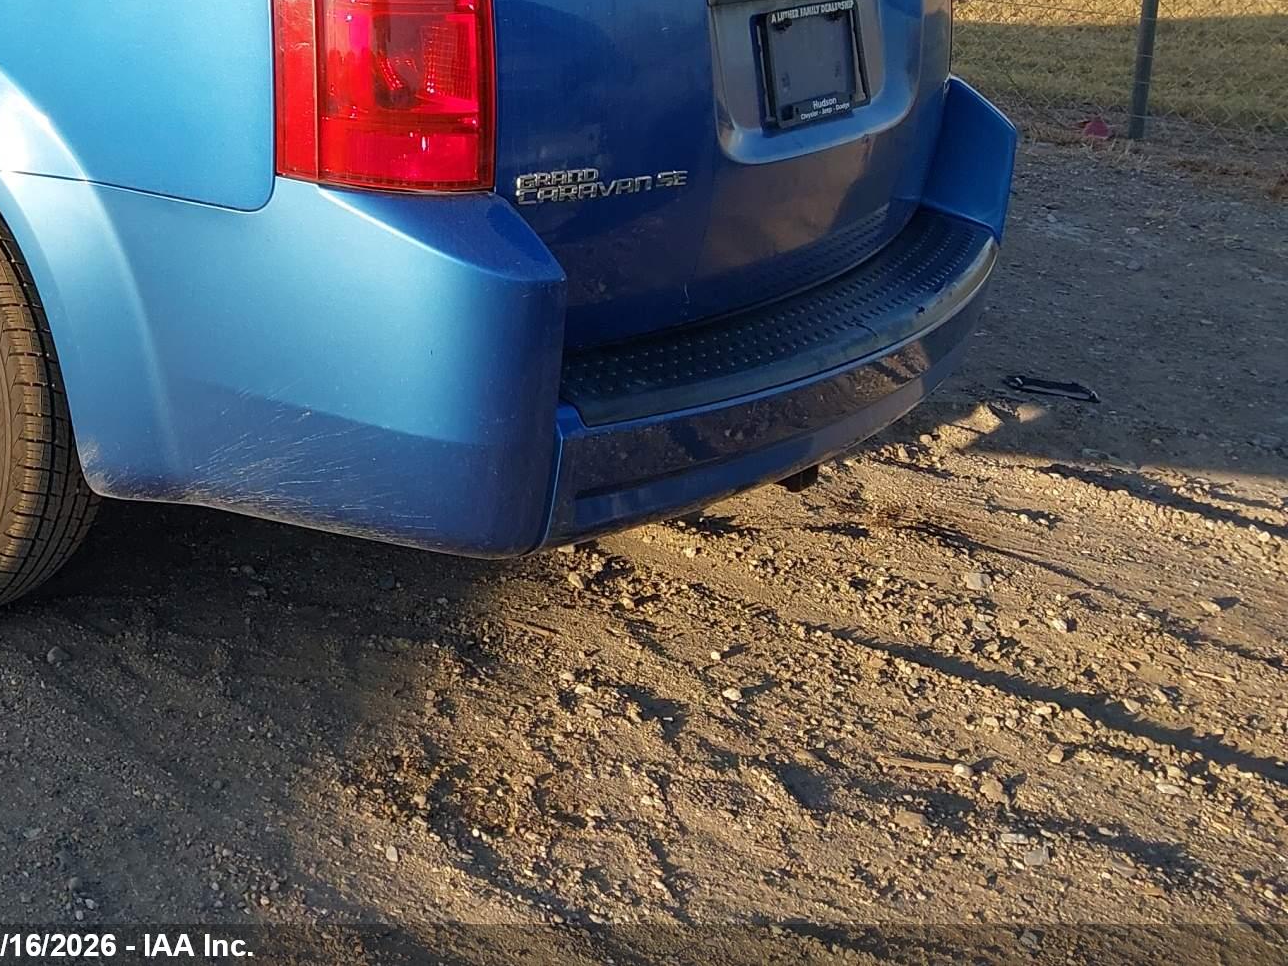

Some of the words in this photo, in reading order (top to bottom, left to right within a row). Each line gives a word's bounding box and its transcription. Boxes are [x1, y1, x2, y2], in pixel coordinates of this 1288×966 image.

[771, 13, 777, 23] A
[777, 9, 799, 22] LUTHER
[799, 5, 820, 17] FAMILY
[820, 0, 854, 14] DEALERSHIP
[812, 97, 837, 110] Hudson
[515, 168, 599, 189] GRAND
[516, 176, 653, 205] CARAVAN
[656, 170, 688, 187] SE
